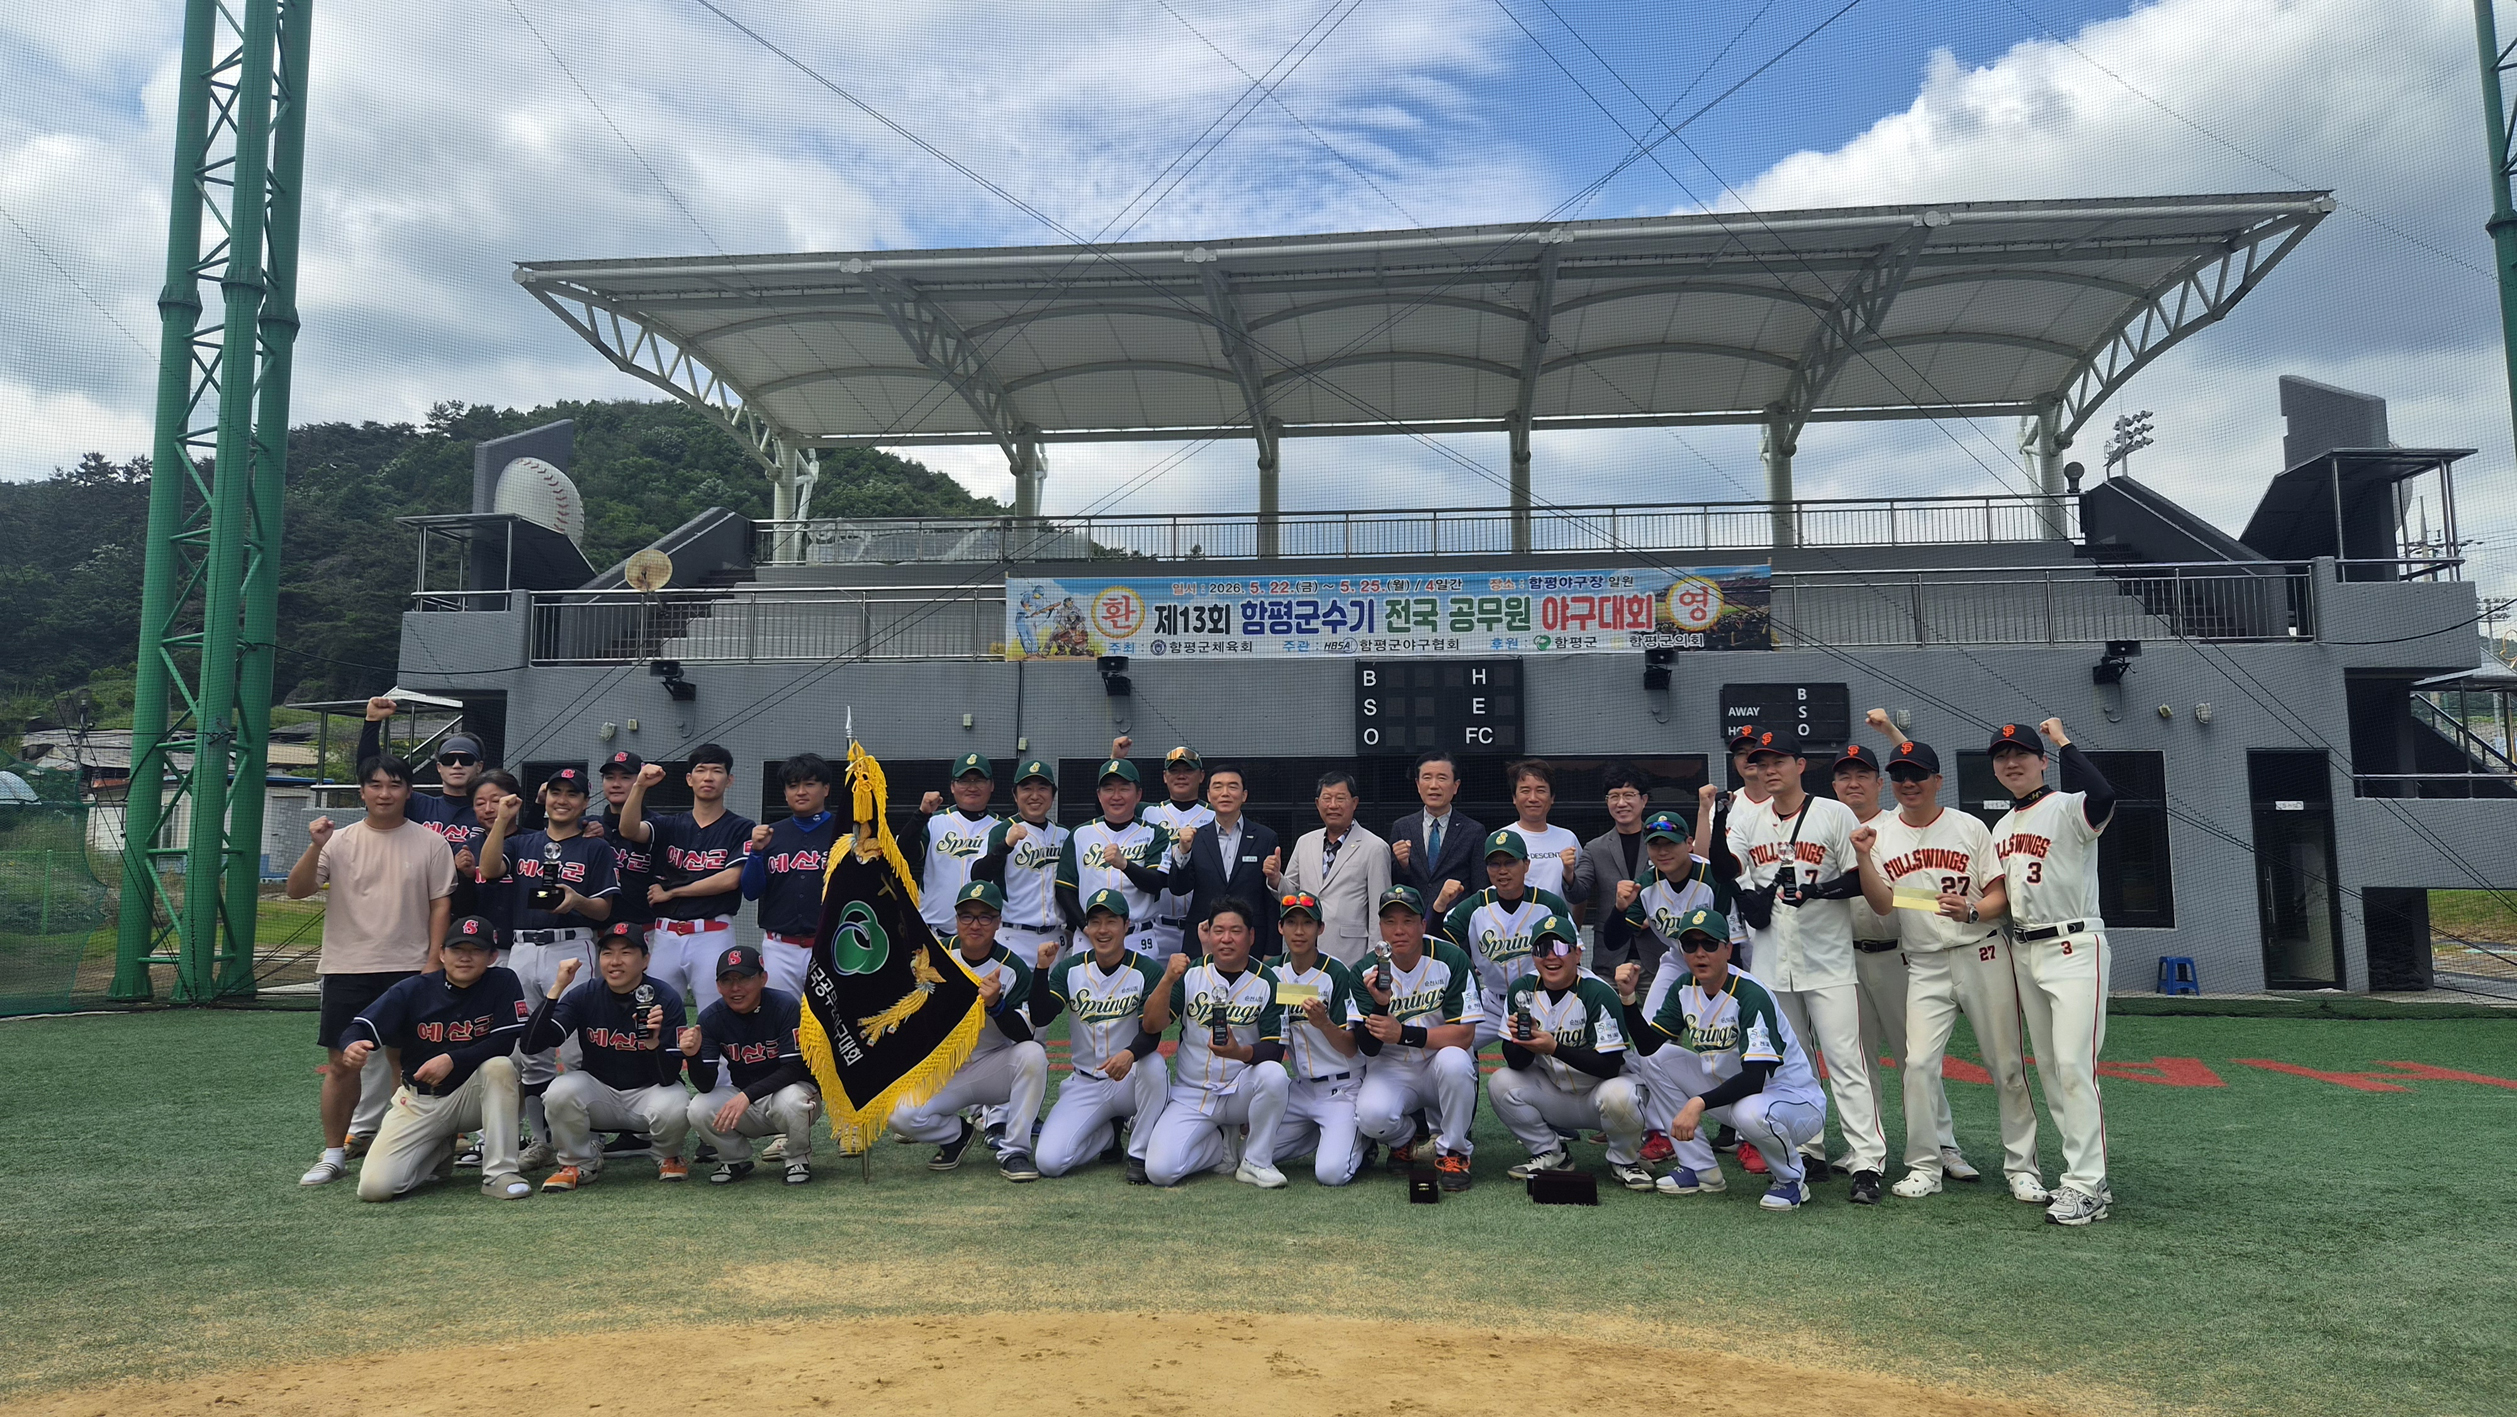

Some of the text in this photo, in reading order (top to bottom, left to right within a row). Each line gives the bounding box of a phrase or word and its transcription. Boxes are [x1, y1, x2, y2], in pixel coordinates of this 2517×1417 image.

[1172, 582, 1196, 595] 일시
[1209, 583, 1245, 594] 2026.
[1425, 578, 1463, 591] 4일간
[1490, 577, 1516, 591] 장소
[1529, 576, 1604, 590] 함평야구장
[1609, 575, 1634, 587] 일원
[1678, 585, 1709, 622] 영
[1101, 595, 1137, 630] 환
[1154, 594, 1653, 635] 제13회 함평군수기 전국 공무원 야구대회
[1108, 642, 1135, 655] 주최
[1169, 640, 1253, 654] 함평군체육회
[1283, 640, 1310, 653] 주관
[1359, 638, 1460, 652] 함평군야구협회
[1490, 638, 1519, 650] 후원
[1554, 636, 1598, 649] 함평군
[1629, 634, 1705, 648] 함평군의회
[1363, 670, 1377, 687] B
[1472, 668, 1487, 685] H
[1797, 688, 1807, 700] B
[1363, 698, 1378, 716] S
[1472, 697, 1486, 715] E
[1728, 705, 1808, 719] AWAY S
[1363, 728, 1379, 745] O
[1465, 727, 1494, 745] FC
[1798, 724, 1810, 736] O
[667, 845, 729, 871] 예산군
[1883, 848, 1970, 882] FULLSWINGS
[1805, 869, 1818, 884] 7
[2026, 862, 2042, 884] 3
[1940, 876, 1970, 896] 27
[1140, 938, 1153, 950] 99
[2060, 940, 2073, 956] 3
[1979, 945, 1996, 962] 27
[1069, 988, 1140, 1018] Springs
[417, 1013, 494, 1042] 예산군
